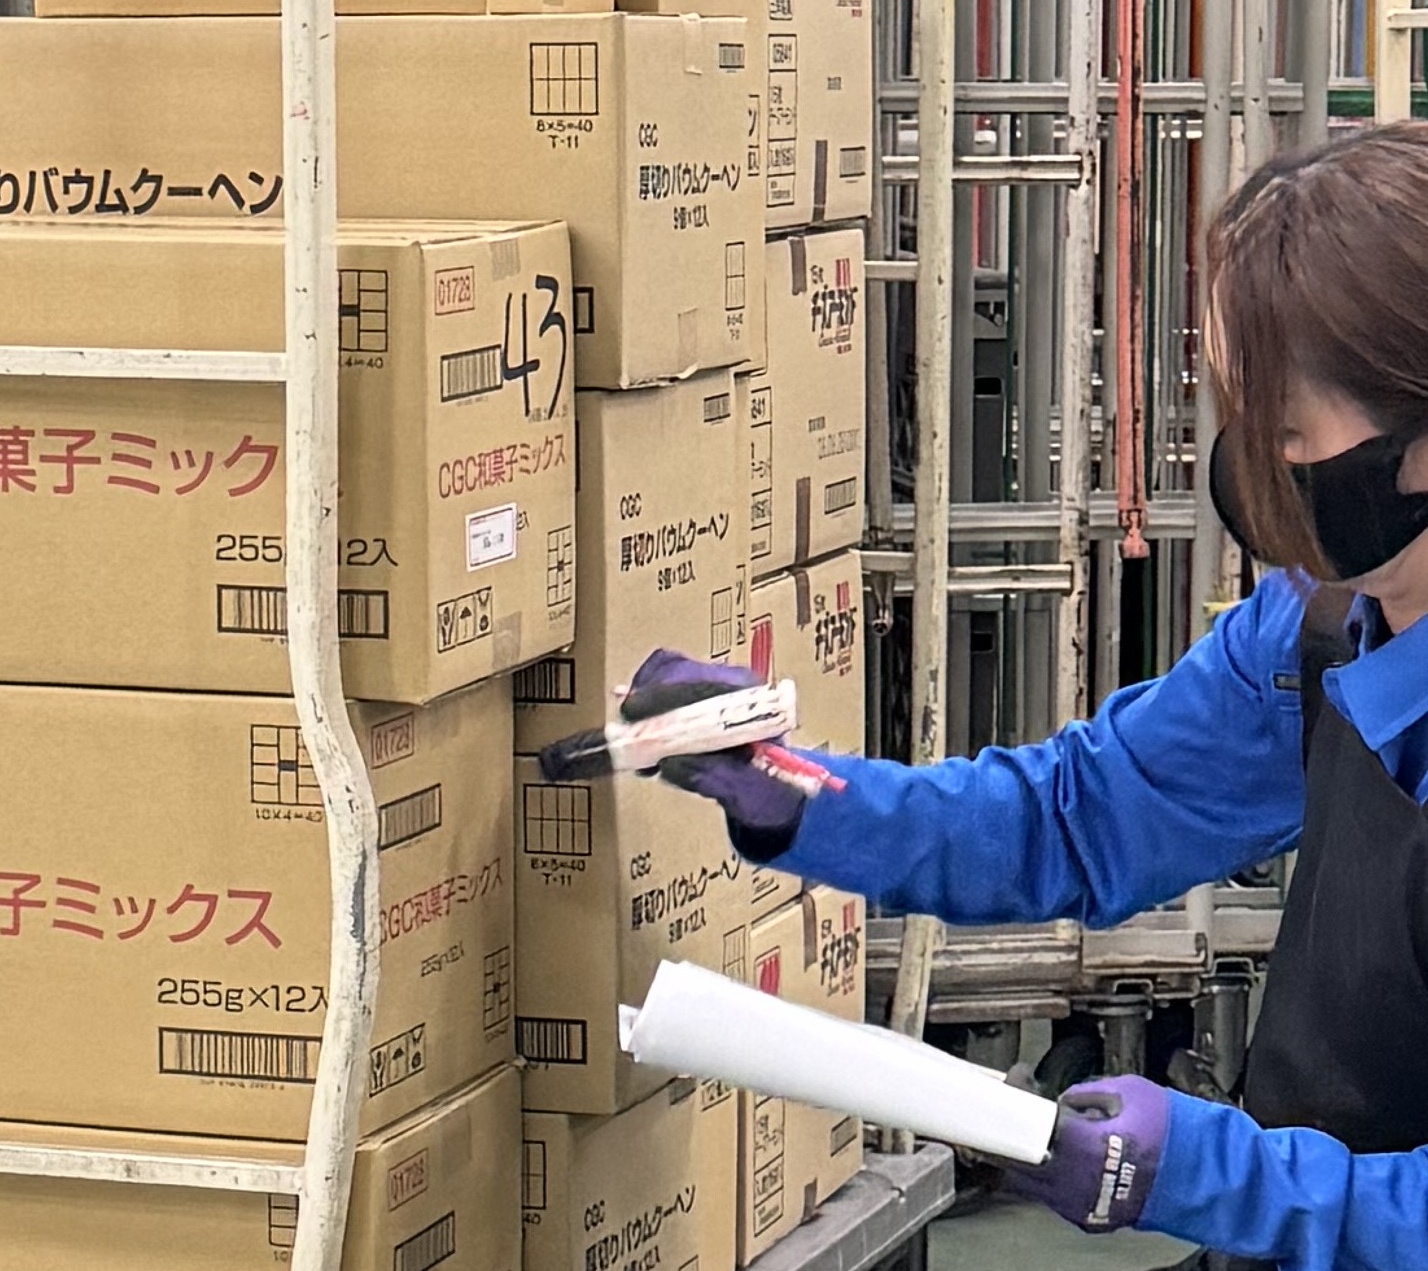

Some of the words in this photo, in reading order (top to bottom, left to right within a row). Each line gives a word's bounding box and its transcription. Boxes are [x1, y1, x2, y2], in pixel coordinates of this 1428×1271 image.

[501, 274, 568, 420] 43
[438, 434, 566, 500] CGC和菓子ミックス
[158, 977, 329, 1014] 255g×12入
